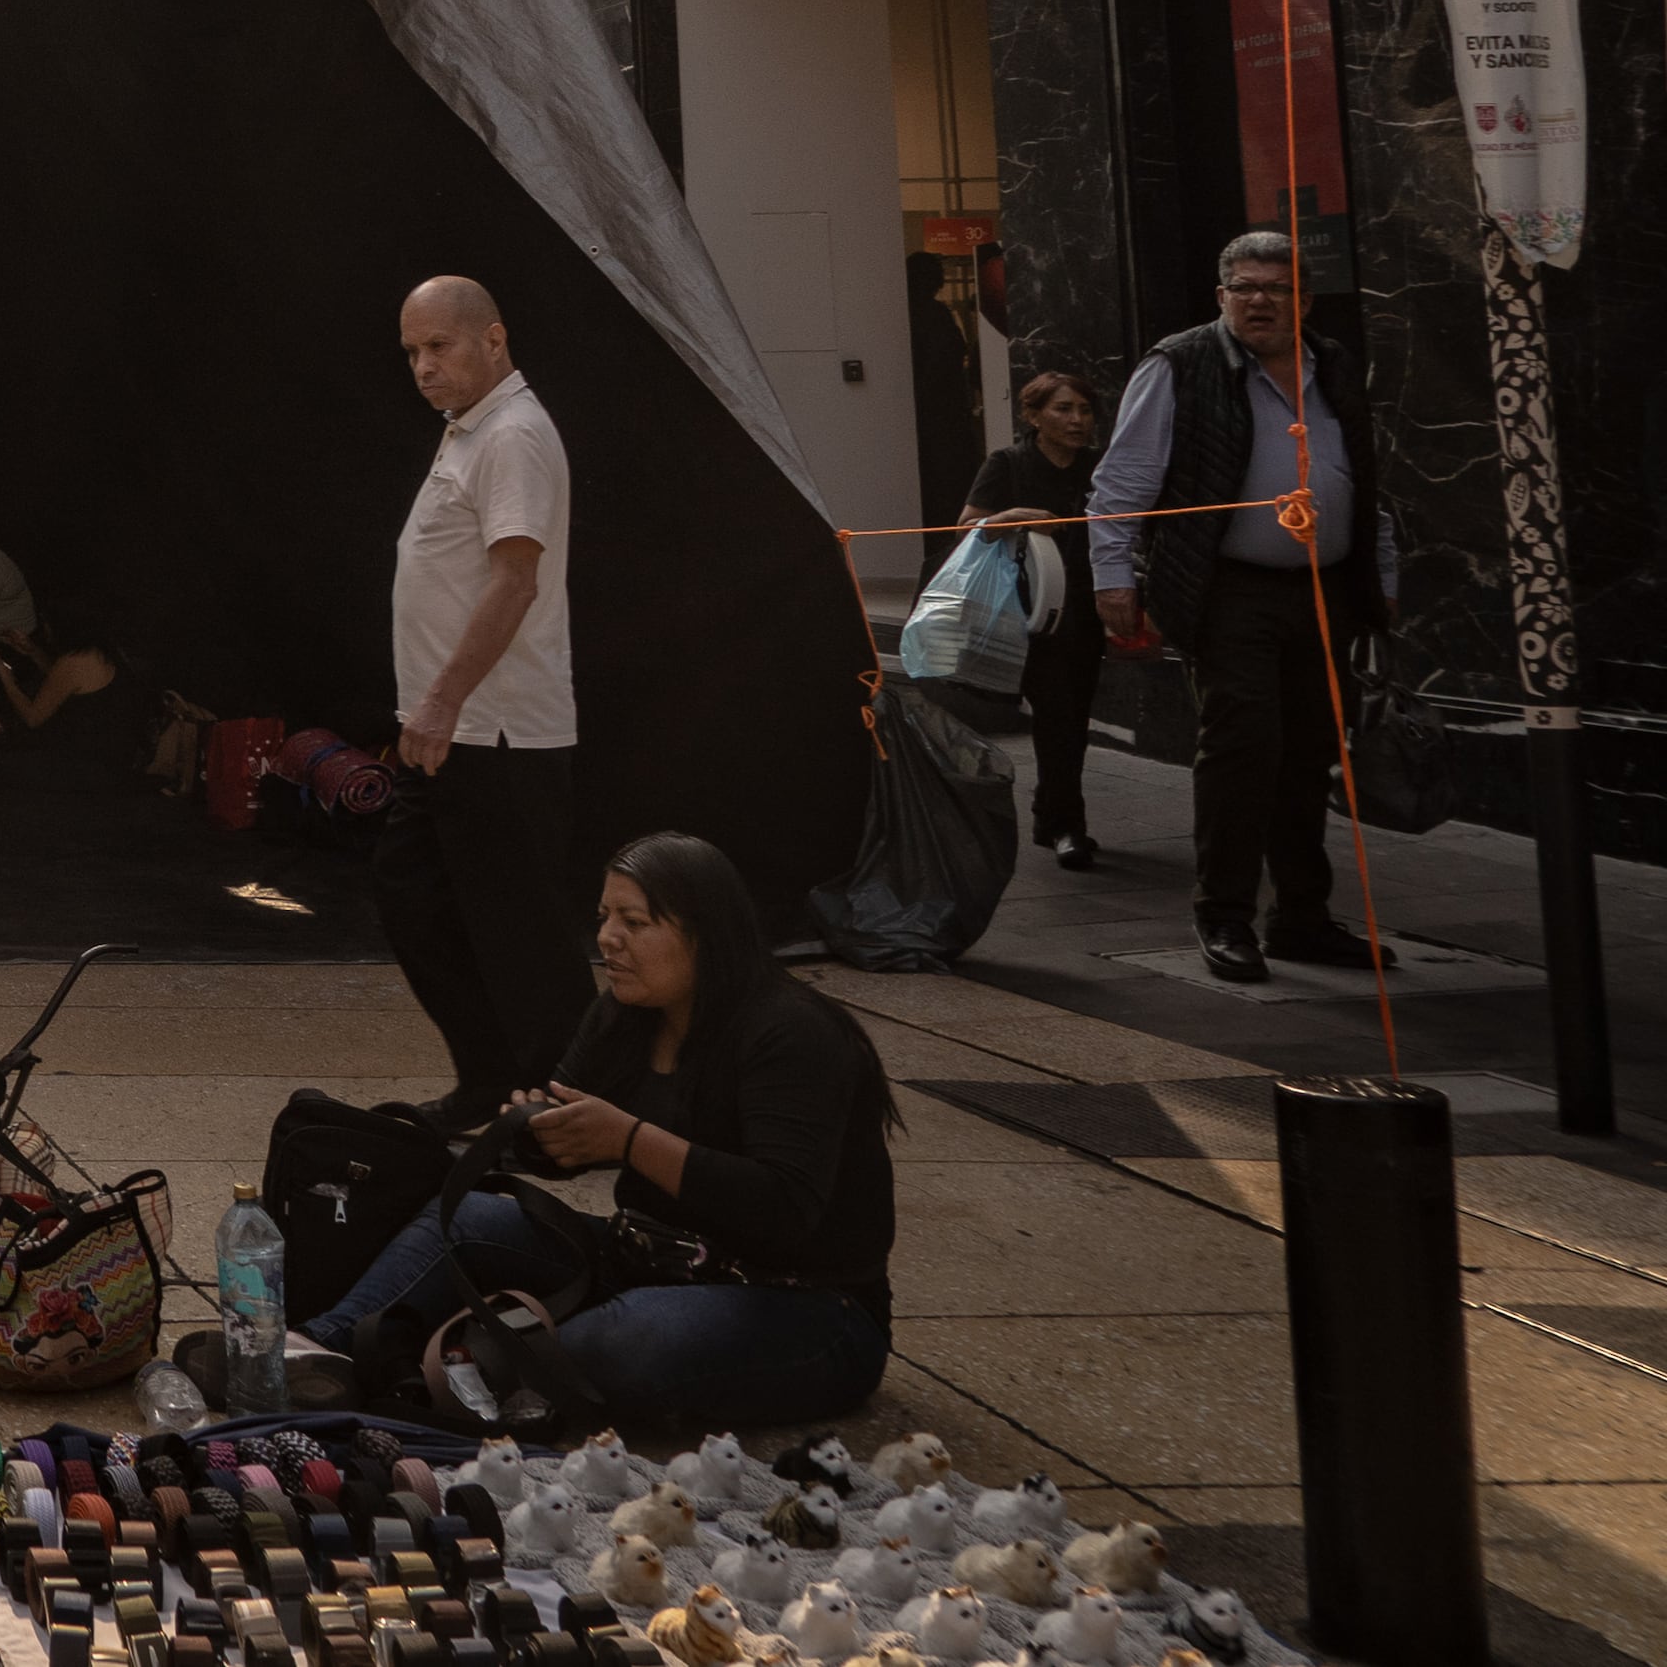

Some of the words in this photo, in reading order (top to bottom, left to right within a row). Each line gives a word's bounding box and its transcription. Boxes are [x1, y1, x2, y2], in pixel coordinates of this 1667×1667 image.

[1482, 2, 1491, 13] Y
[1465, 35, 1516, 51] EVITA
[1470, 54, 1483, 70] Y
